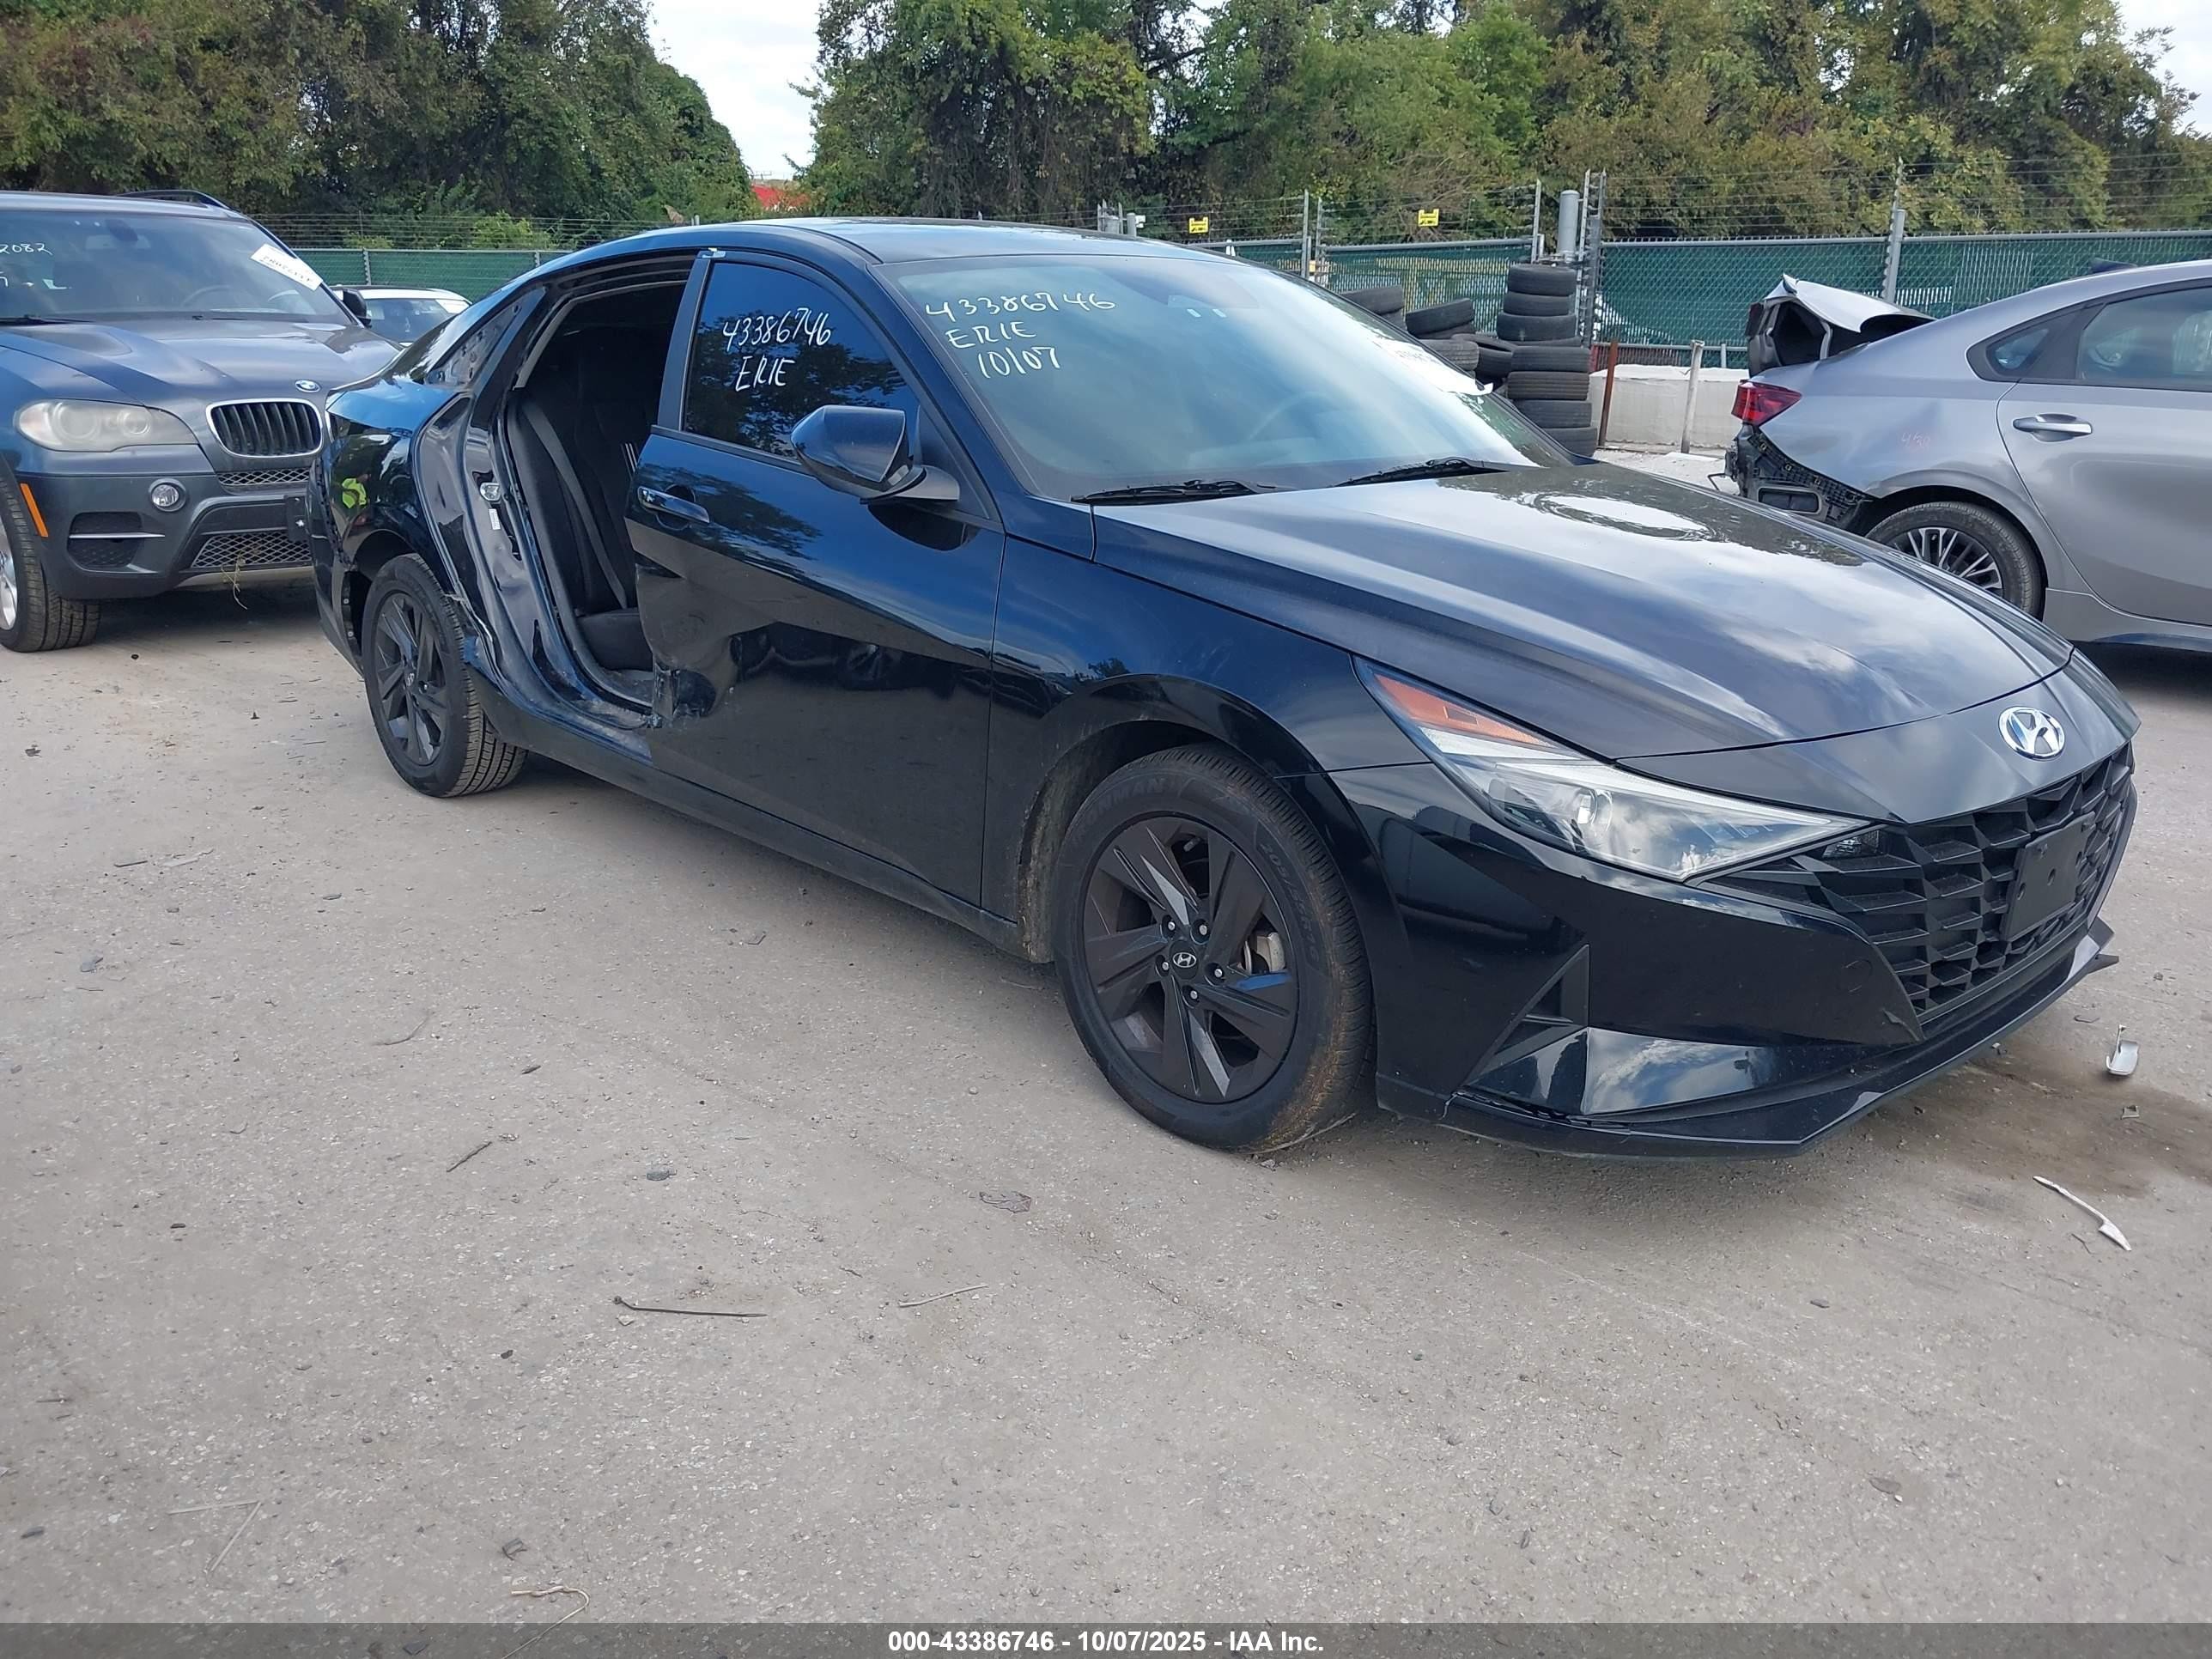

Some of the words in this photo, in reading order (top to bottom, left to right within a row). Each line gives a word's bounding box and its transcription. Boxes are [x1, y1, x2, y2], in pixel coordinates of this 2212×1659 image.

[926, 292, 1116, 322] 43386746
[722, 307, 831, 353] 43386746
[945, 321, 1037, 349] ERIE
[735, 354, 796, 392] ERIE
[977, 346, 1061, 378] 10/07
